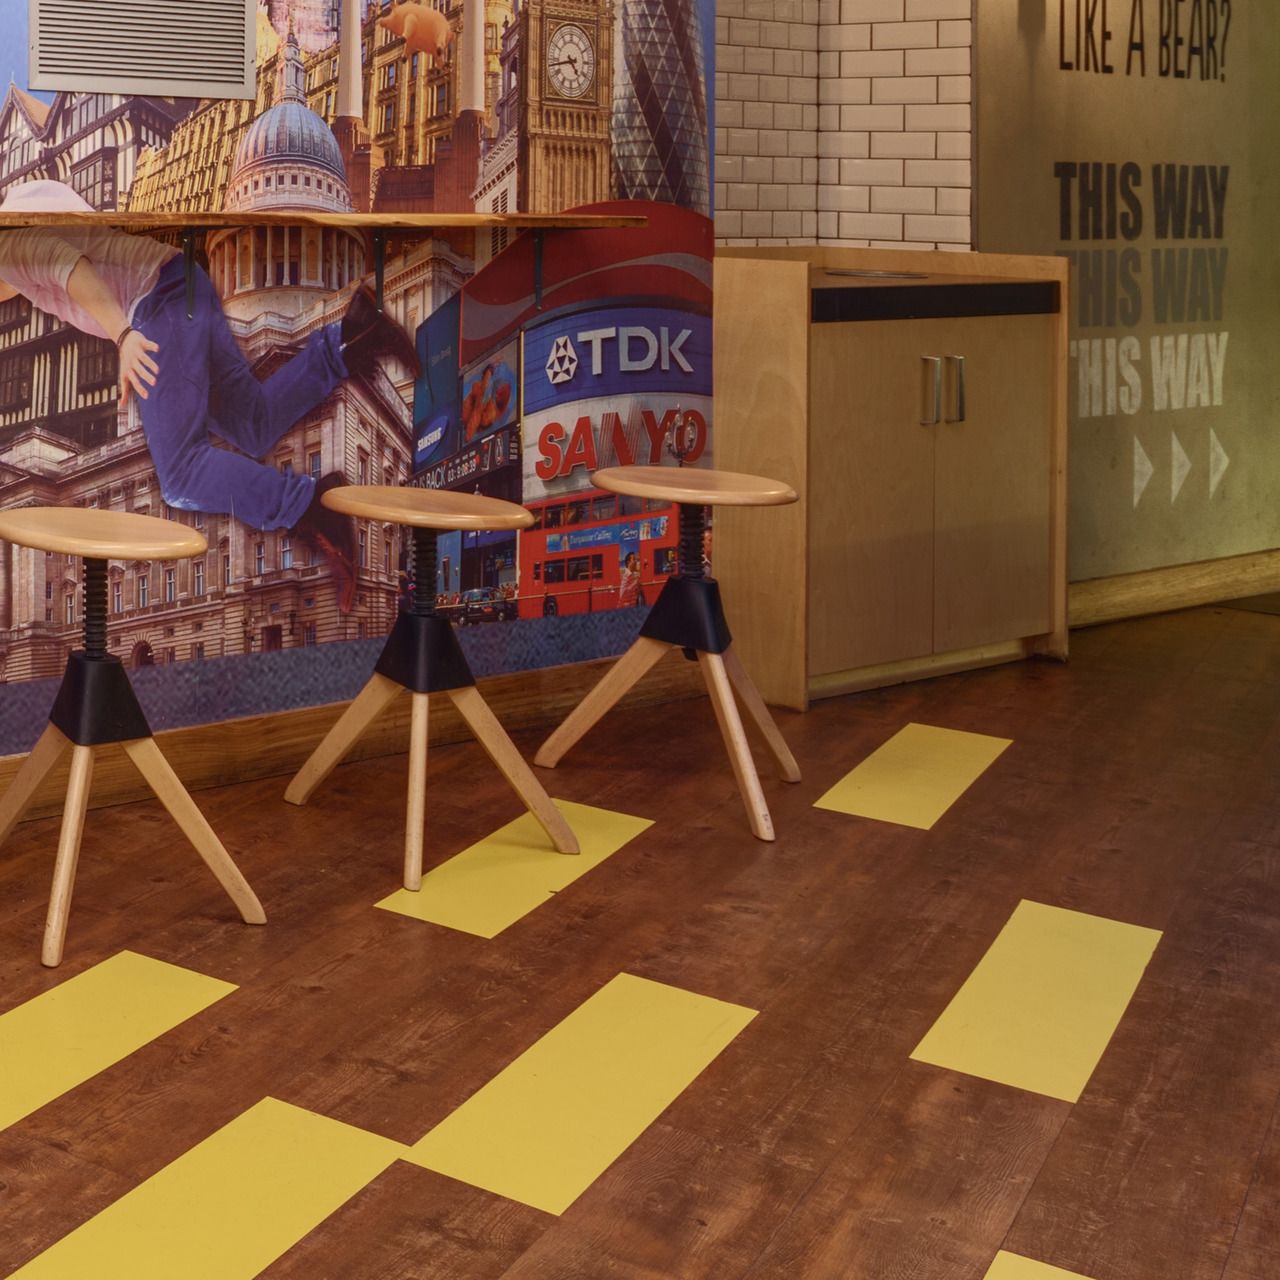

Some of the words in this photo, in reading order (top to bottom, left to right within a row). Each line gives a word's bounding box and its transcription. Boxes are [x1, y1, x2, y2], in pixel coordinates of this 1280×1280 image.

[1053, 161, 1143, 241] THIS
[1151, 163, 1230, 240] WAY
[1151, 247, 1230, 324] WAY
[577, 326, 695, 375] TDK
[1069, 335, 1143, 418] HIS
[1149, 331, 1230, 412] WAY
[417, 427, 443, 452] SAMSUNG
[535, 407, 708, 482] SANYO
